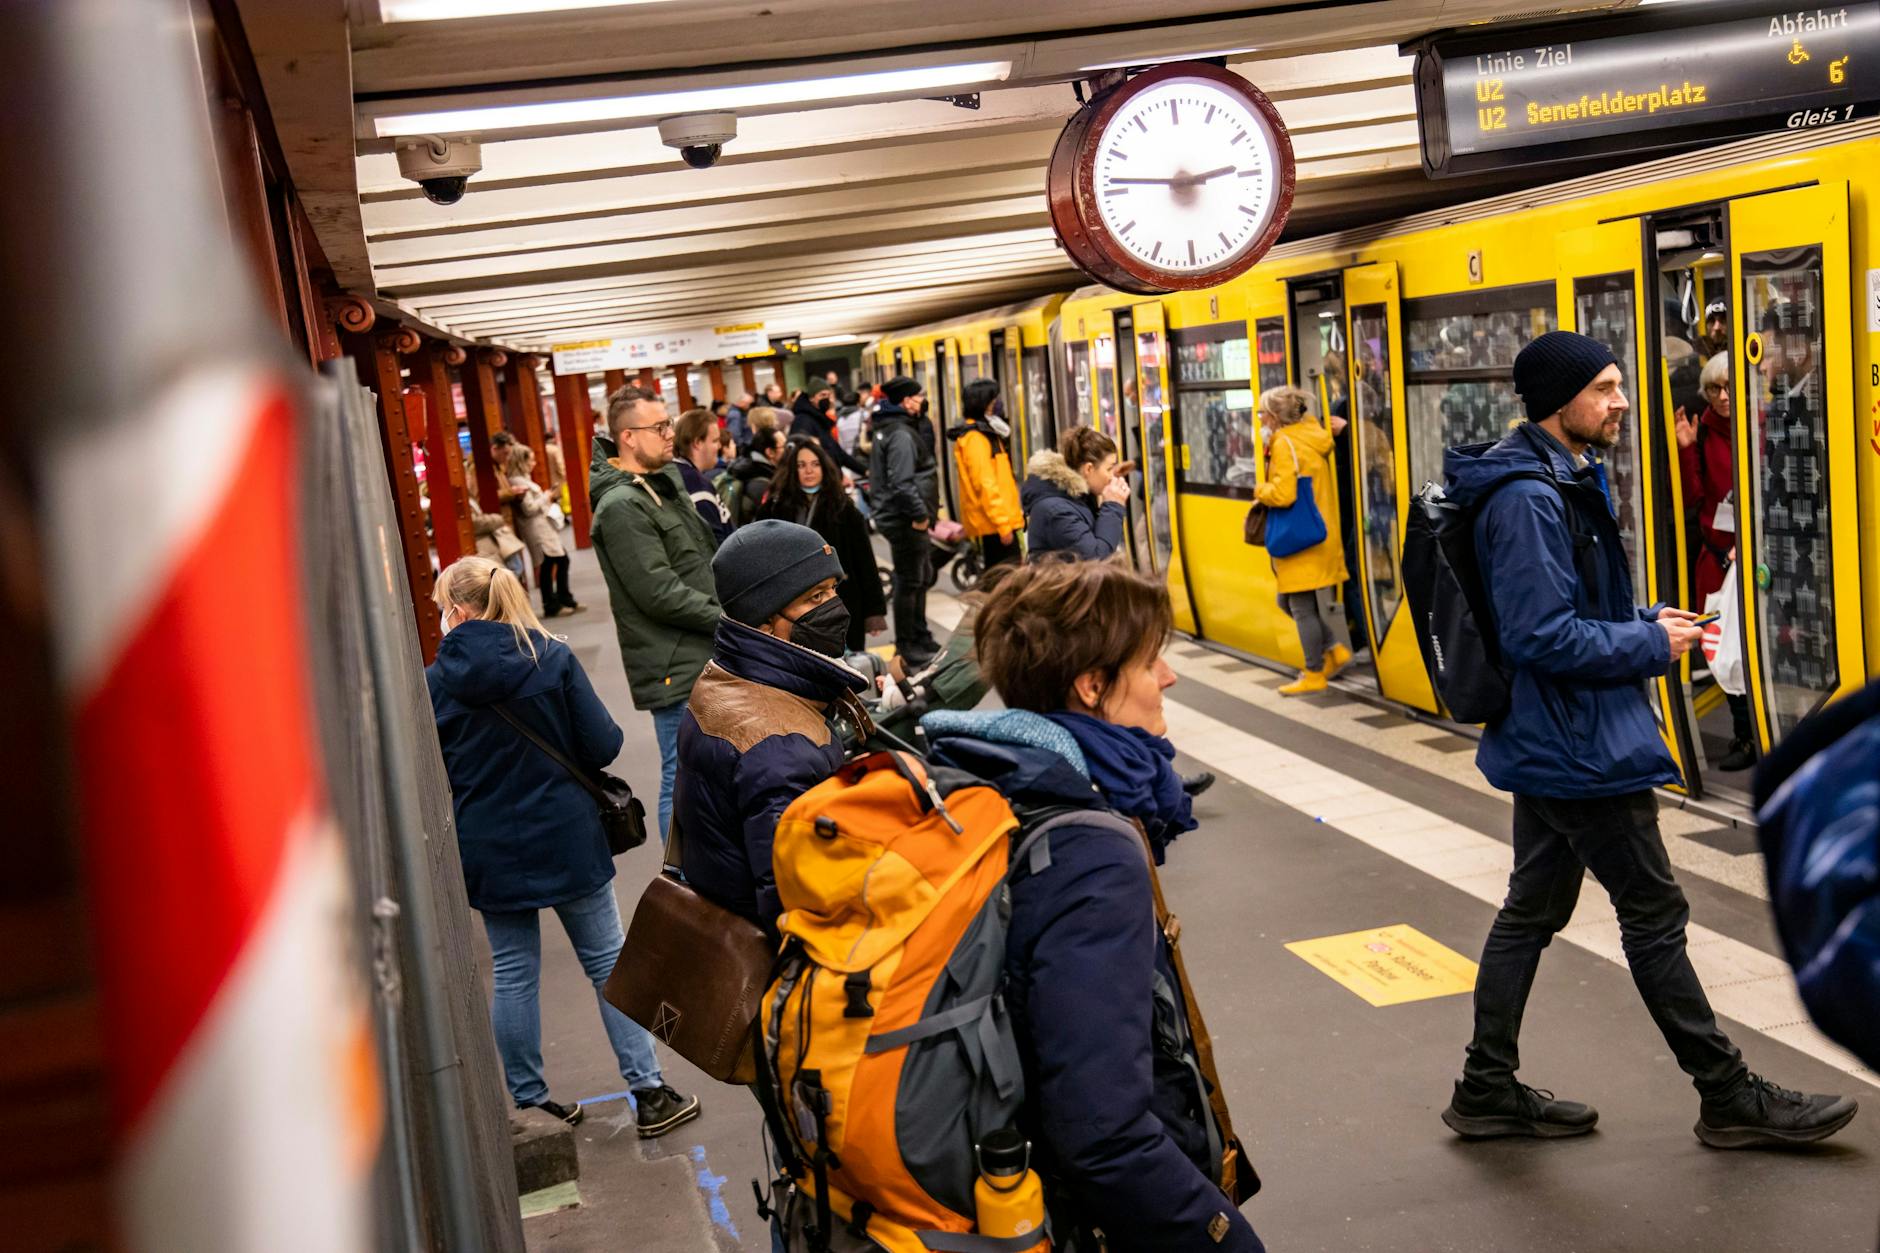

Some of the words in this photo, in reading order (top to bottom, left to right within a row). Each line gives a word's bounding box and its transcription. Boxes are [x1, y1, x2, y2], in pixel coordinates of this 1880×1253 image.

[1768, 8, 1848, 37] Abfahrt
[1476, 52, 1525, 76] Linie
[1535, 44, 1572, 68] Ziel
[1476, 78, 1504, 102] U2
[1478, 106, 1507, 131] U2
[1527, 81, 1706, 125] Senefelderplatz
[1787, 107, 1837, 128] Gleis
[1844, 104, 1854, 120] 1
